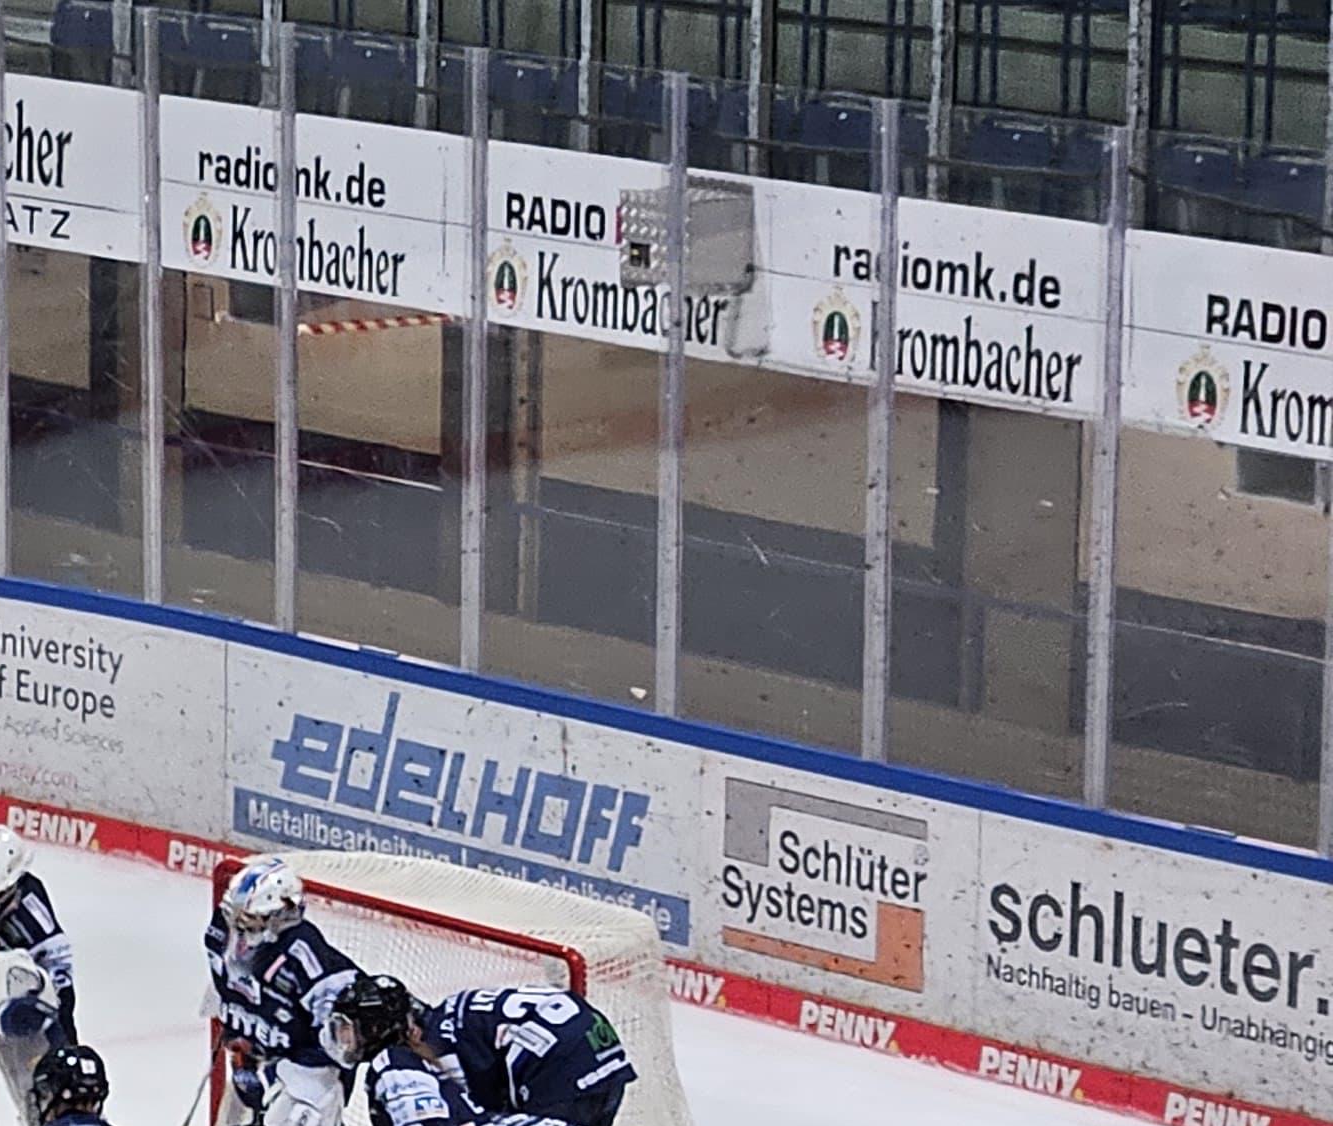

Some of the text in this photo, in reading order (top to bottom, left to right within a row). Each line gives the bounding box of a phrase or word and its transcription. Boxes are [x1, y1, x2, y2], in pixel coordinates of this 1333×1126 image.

[506, 191, 606, 241] RADIO
[834, 242, 1061, 309] raiomk.de
[1206, 294, 1327, 350] RADIO
[16, 669, 115, 722] Europe
[779, 830, 928, 903] Schlüter
[722, 865, 868, 940] Systems
[986, 954, 1101, 1007] Nachhaltig
[1108, 986, 1176, 1023] bauen
